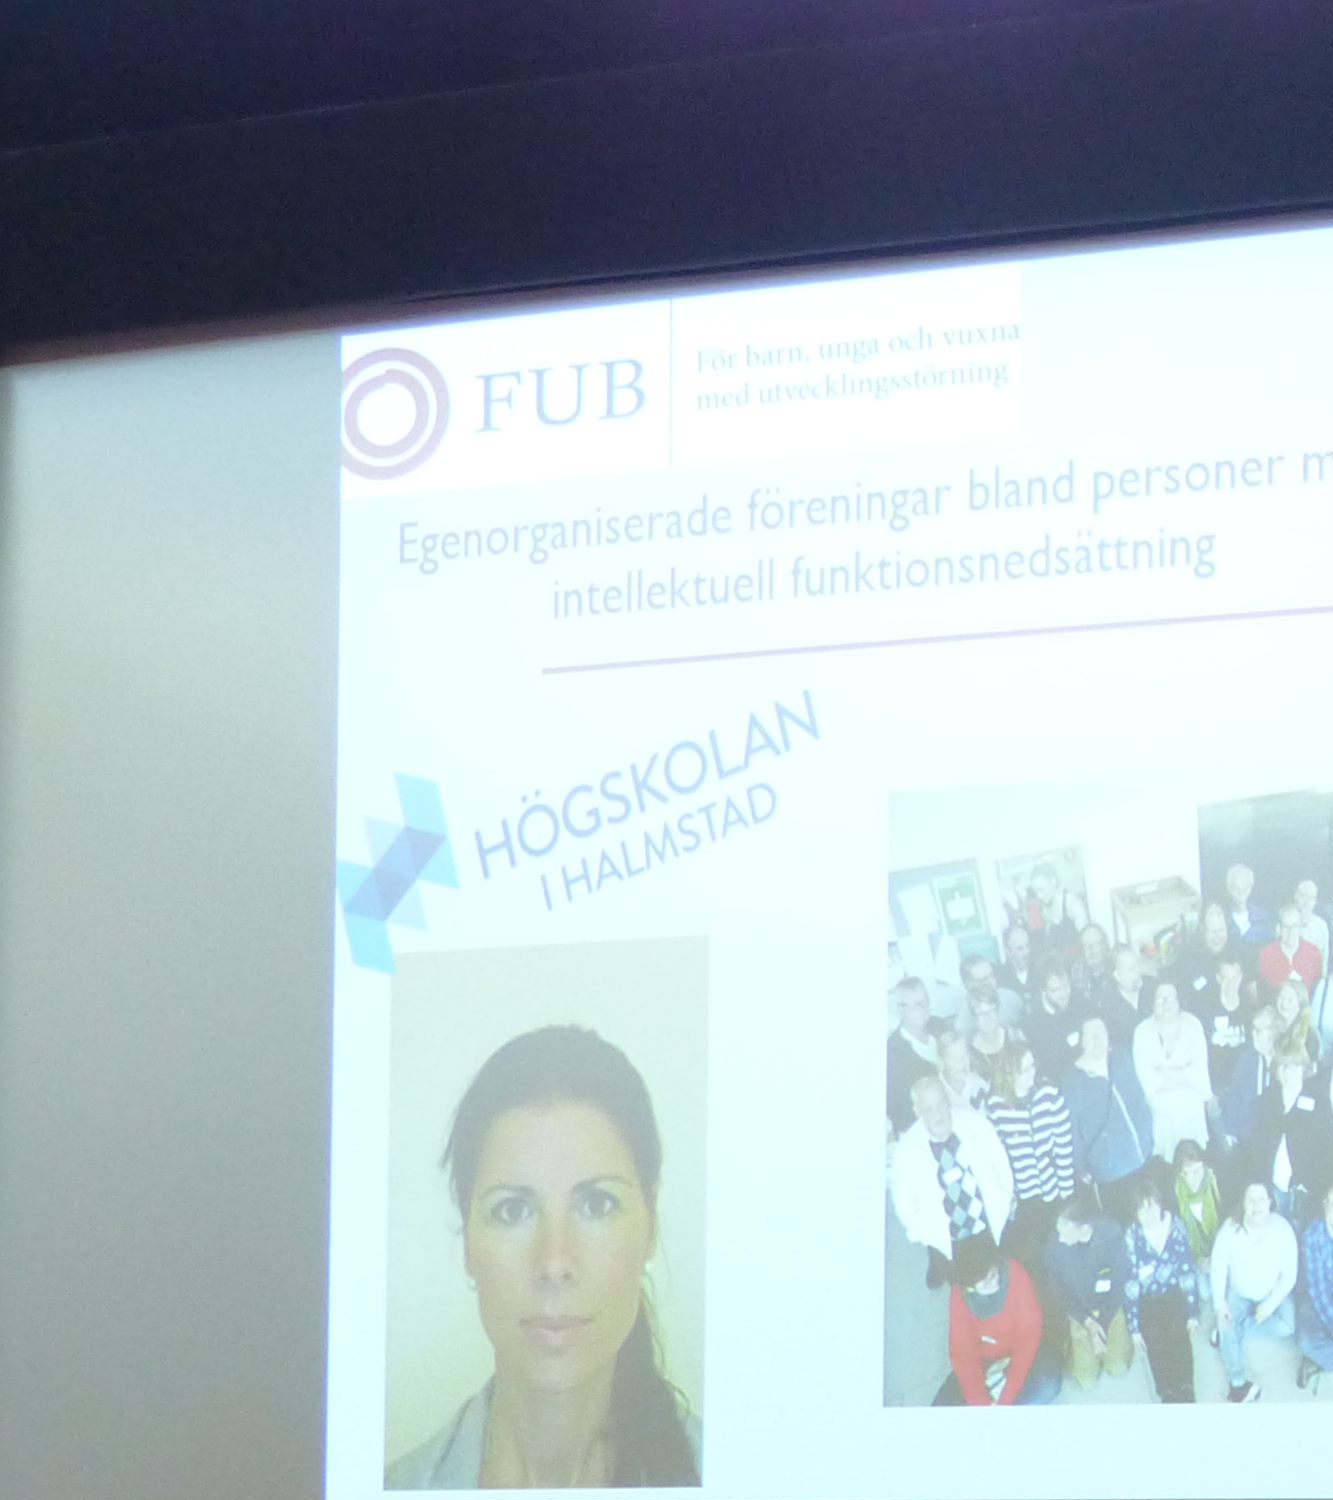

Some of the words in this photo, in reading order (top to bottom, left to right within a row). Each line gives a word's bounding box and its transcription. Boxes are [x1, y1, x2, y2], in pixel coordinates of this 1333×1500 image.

[697, 349, 737, 372] För
[746, 344, 810, 367] barn,
[819, 339, 880, 364] unga
[889, 326, 933, 352] och
[943, 324, 1021, 346] vuxna
[697, 382, 750, 410] med
[758, 359, 1009, 400] utvecklingsstörning
[476, 359, 646, 432] FUB
[399, 494, 732, 576] Egenorganiserade
[747, 487, 951, 532] föreningar
[969, 459, 1074, 511] bland
[1093, 455, 1285, 515] personer
[554, 558, 774, 618] intellektuell
[790, 528, 1216, 599] funktionsnedsättning
[474, 689, 820, 880] HÖGSKOLAN
[541, 875, 553, 911] I
[561, 782, 777, 903] HALMSTAD
